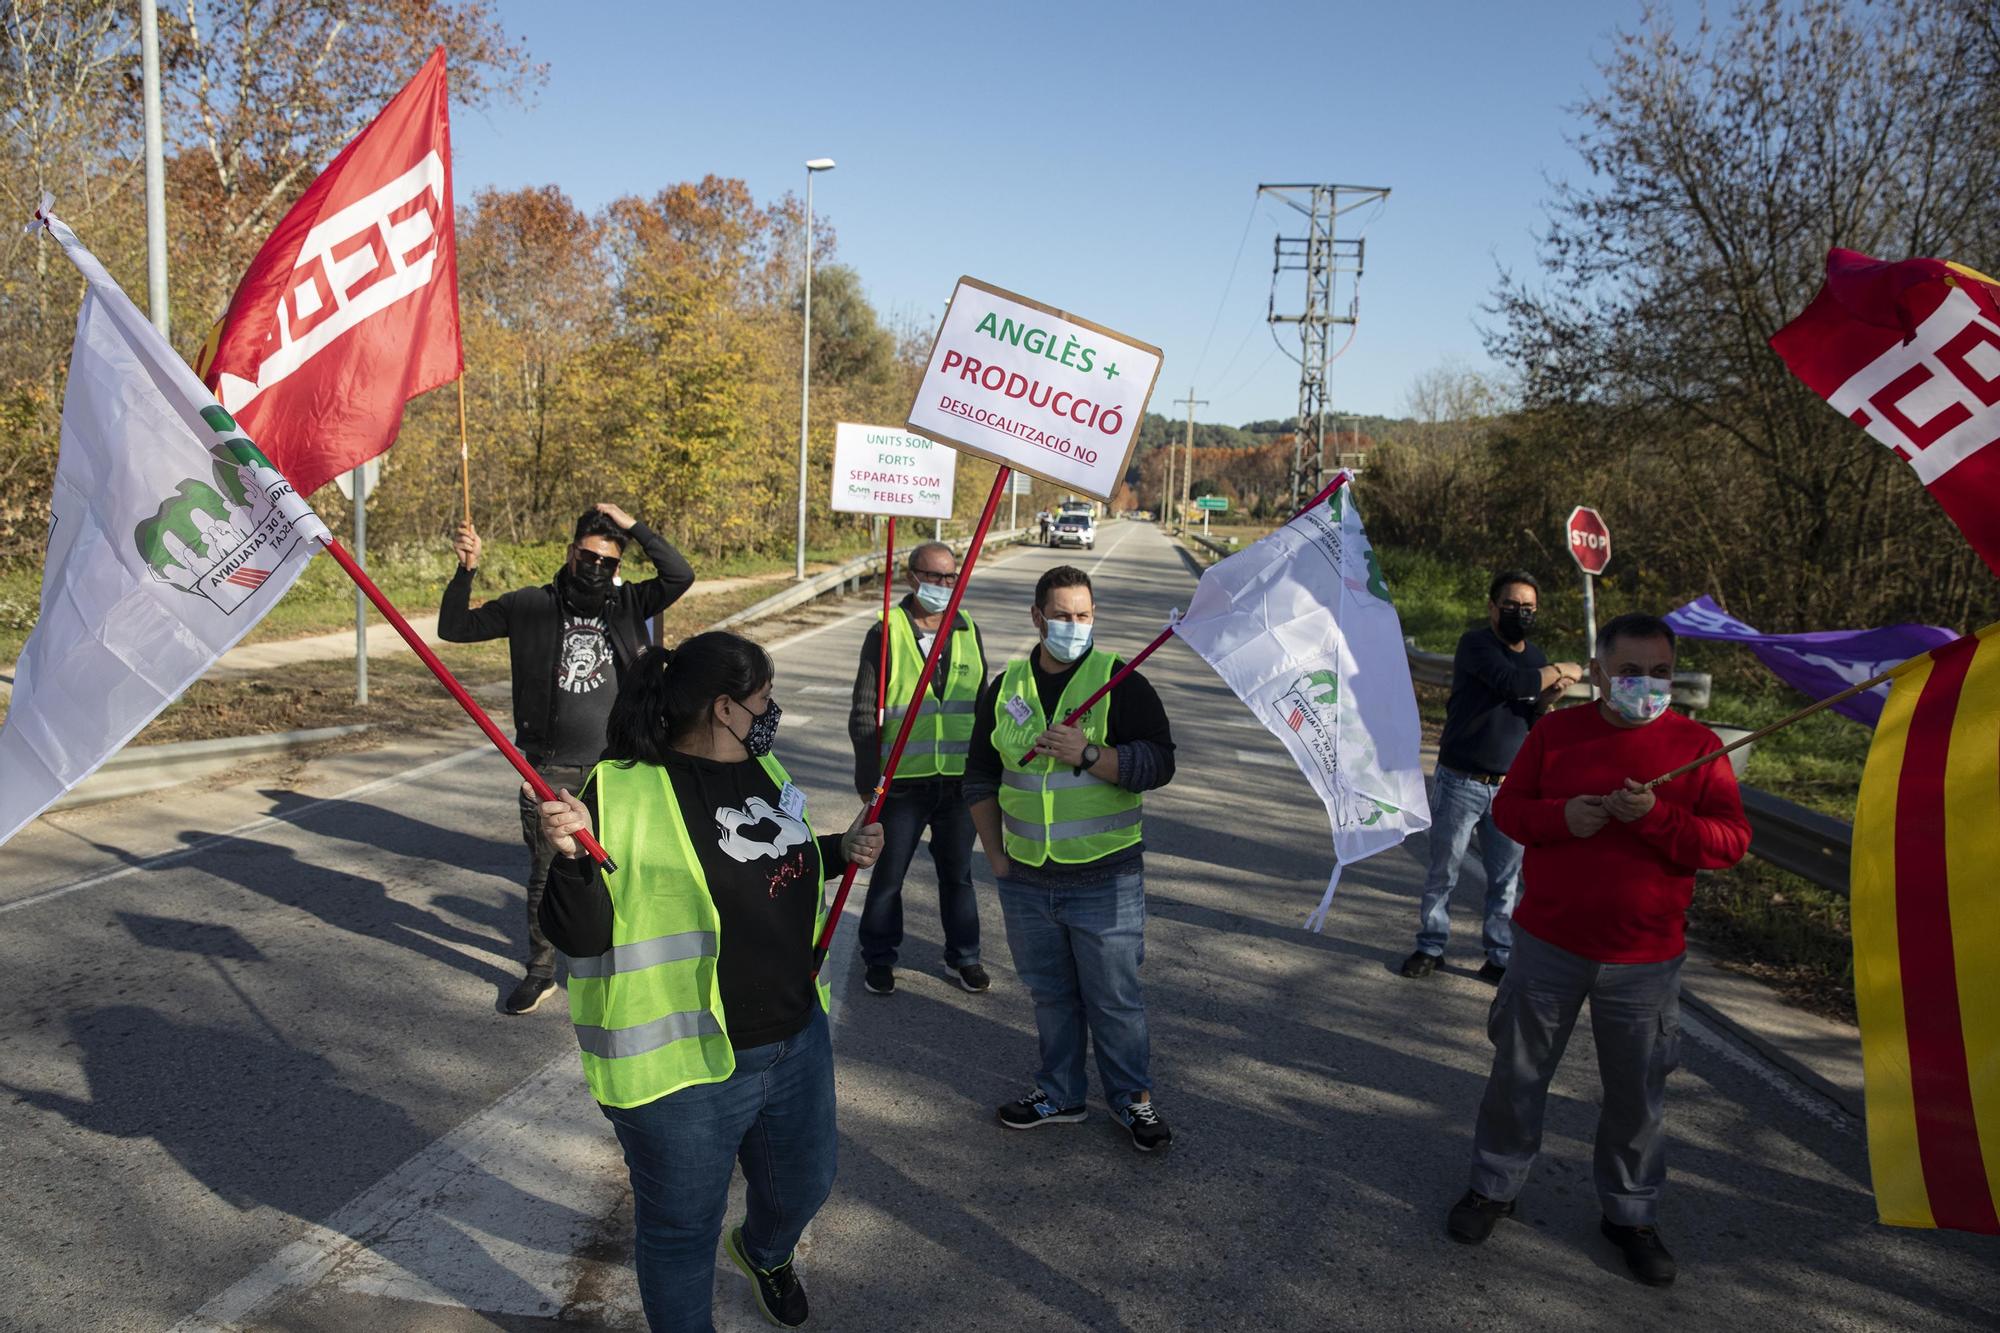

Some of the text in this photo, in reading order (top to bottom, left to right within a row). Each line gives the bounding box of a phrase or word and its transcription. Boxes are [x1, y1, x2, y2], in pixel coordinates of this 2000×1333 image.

[975, 312, 1097, 373] ANGLÈS
[940, 349, 1123, 435] PRODUCCIÓ
[940, 395, 1098, 463] DESLOCALITZACIÓ NO
[866, 433, 933, 449] UNITS SOM
[878, 453, 916, 466] FORTS
[850, 470, 940, 487] SEPARATS SOM
[873, 491, 914, 504] FEBLES
[1572, 530, 1606, 549] STOP
